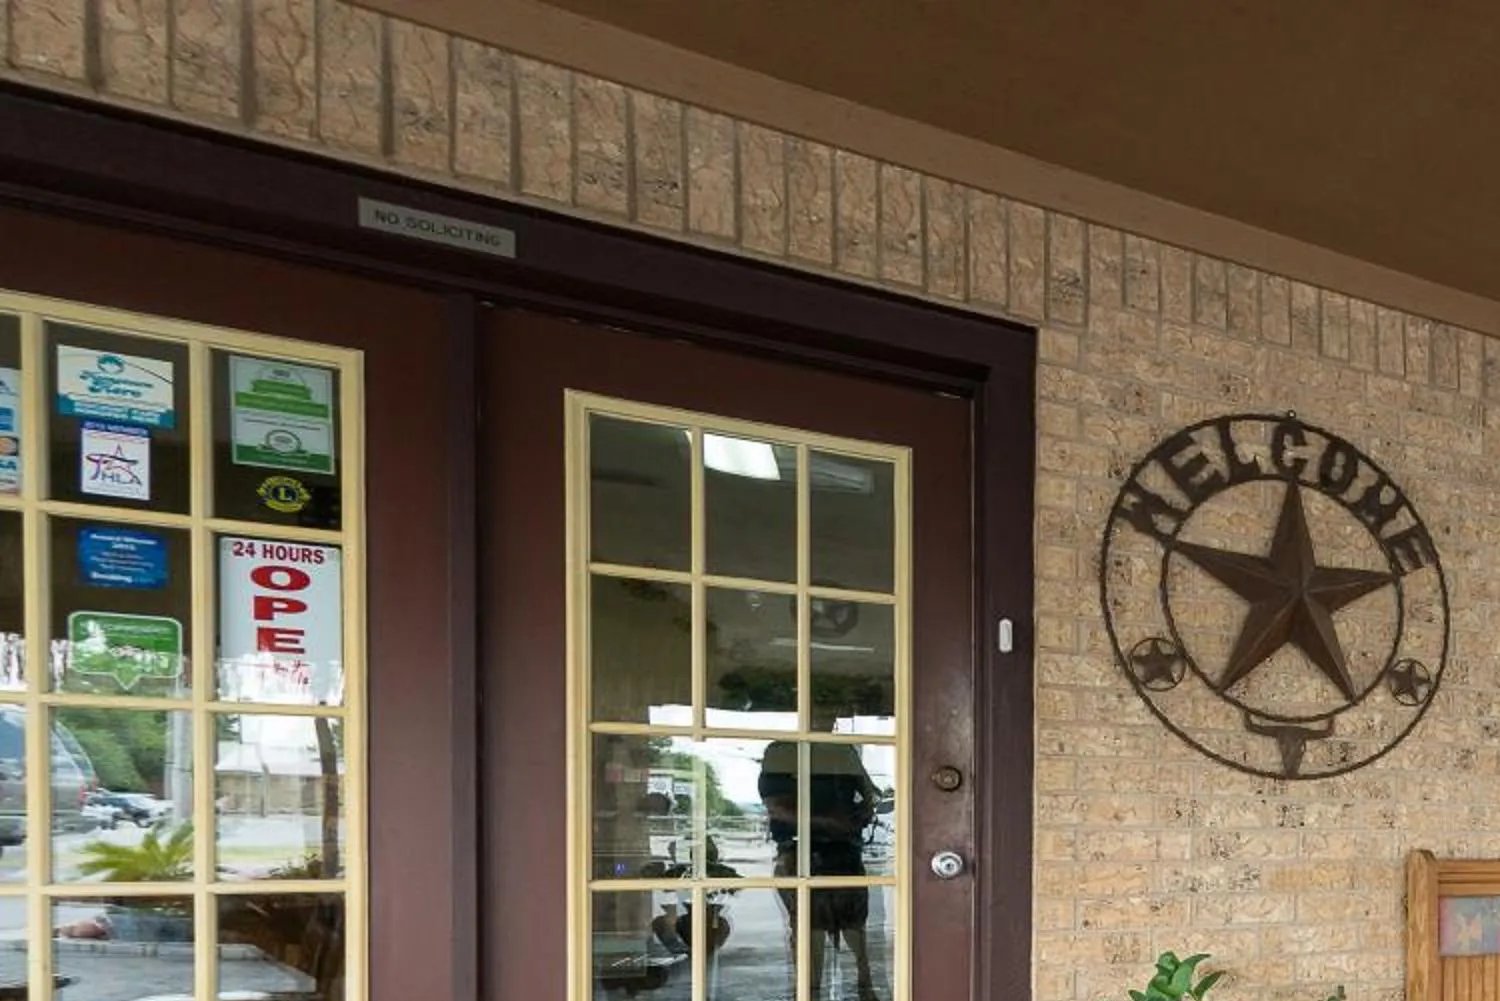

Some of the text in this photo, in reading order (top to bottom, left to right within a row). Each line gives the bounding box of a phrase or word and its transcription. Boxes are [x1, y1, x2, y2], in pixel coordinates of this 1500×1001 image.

[375, 209, 503, 247] NO SOLICITING
[1113, 415, 1440, 577] WELCOME
[232, 541, 325, 565] 24 HOURS
[250, 565, 311, 686] OPE
